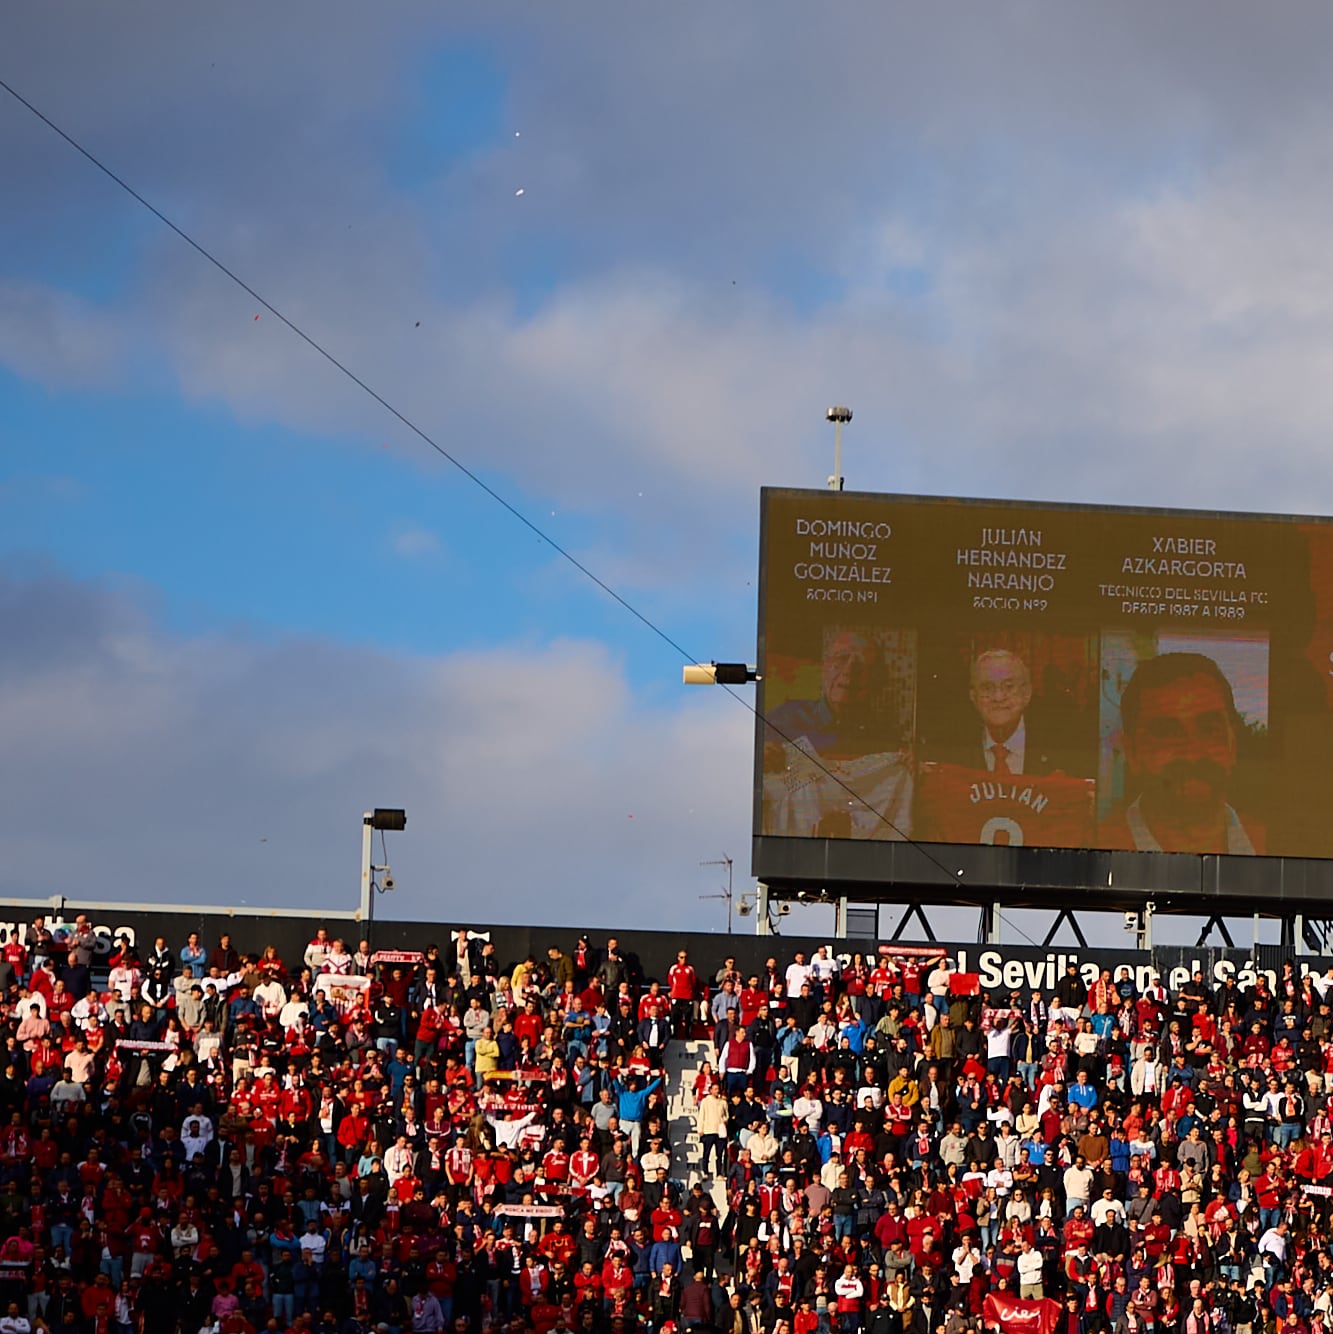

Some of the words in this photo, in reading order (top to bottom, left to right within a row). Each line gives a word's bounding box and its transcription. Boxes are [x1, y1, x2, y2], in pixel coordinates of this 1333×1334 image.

[796, 519, 891, 540] DOMINGO
[809, 541, 877, 560] MUÑOZ
[1152, 537, 1217, 555] XABIER
[956, 549, 1067, 570] HERNÁNDEZ
[1121, 558, 1247, 579] AZKARGORTA
[793, 562, 892, 584] GONZÁLEZ
[967, 572, 1055, 592] NARANJO
[806, 588, 853, 604] SOCIO
[973, 596, 1020, 610] SOCIO
[1165, 588, 1191, 601] DEL
[1193, 589, 1247, 603] SEVILLA
[1202, 606, 1211, 617] A
[969, 782, 1049, 814] JULIÁN
